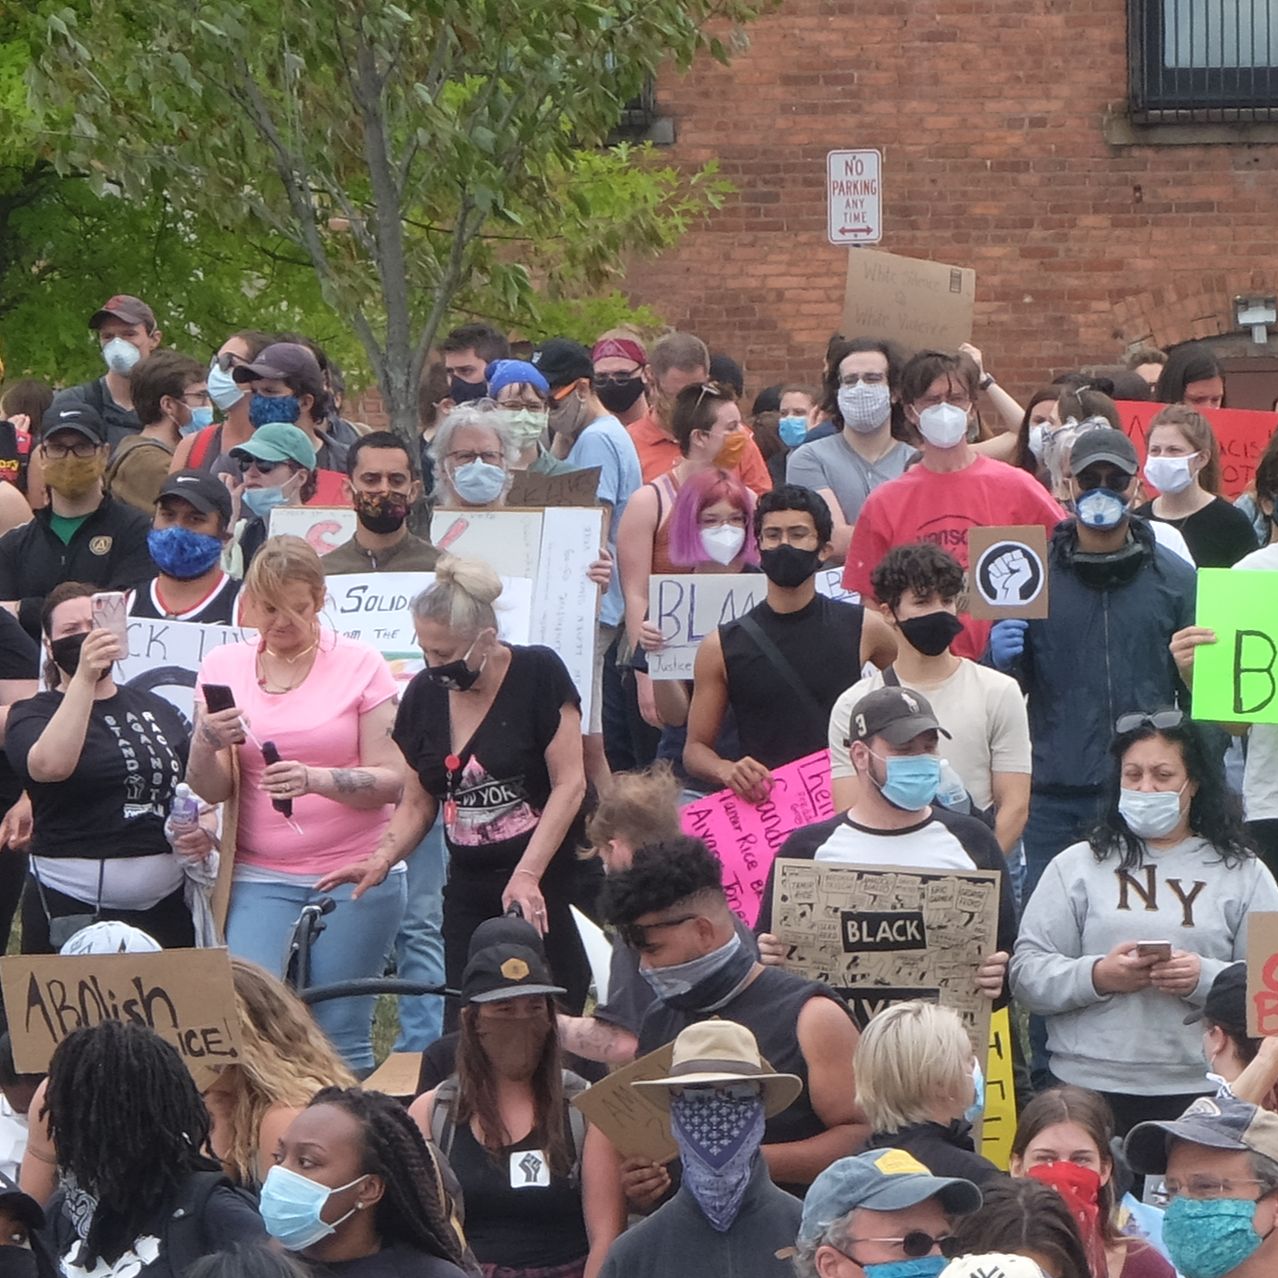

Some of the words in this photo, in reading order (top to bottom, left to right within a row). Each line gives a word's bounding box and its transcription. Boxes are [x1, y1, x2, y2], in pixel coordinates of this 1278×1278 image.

[845, 158, 864, 176] NO
[832, 179, 877, 196] PARKING
[845, 199, 865, 209] ANY
[843, 211, 867, 223] TIME
[654, 655, 692, 672] Justice
[1114, 864, 1207, 928] NY
[847, 919, 922, 943] BLACK
